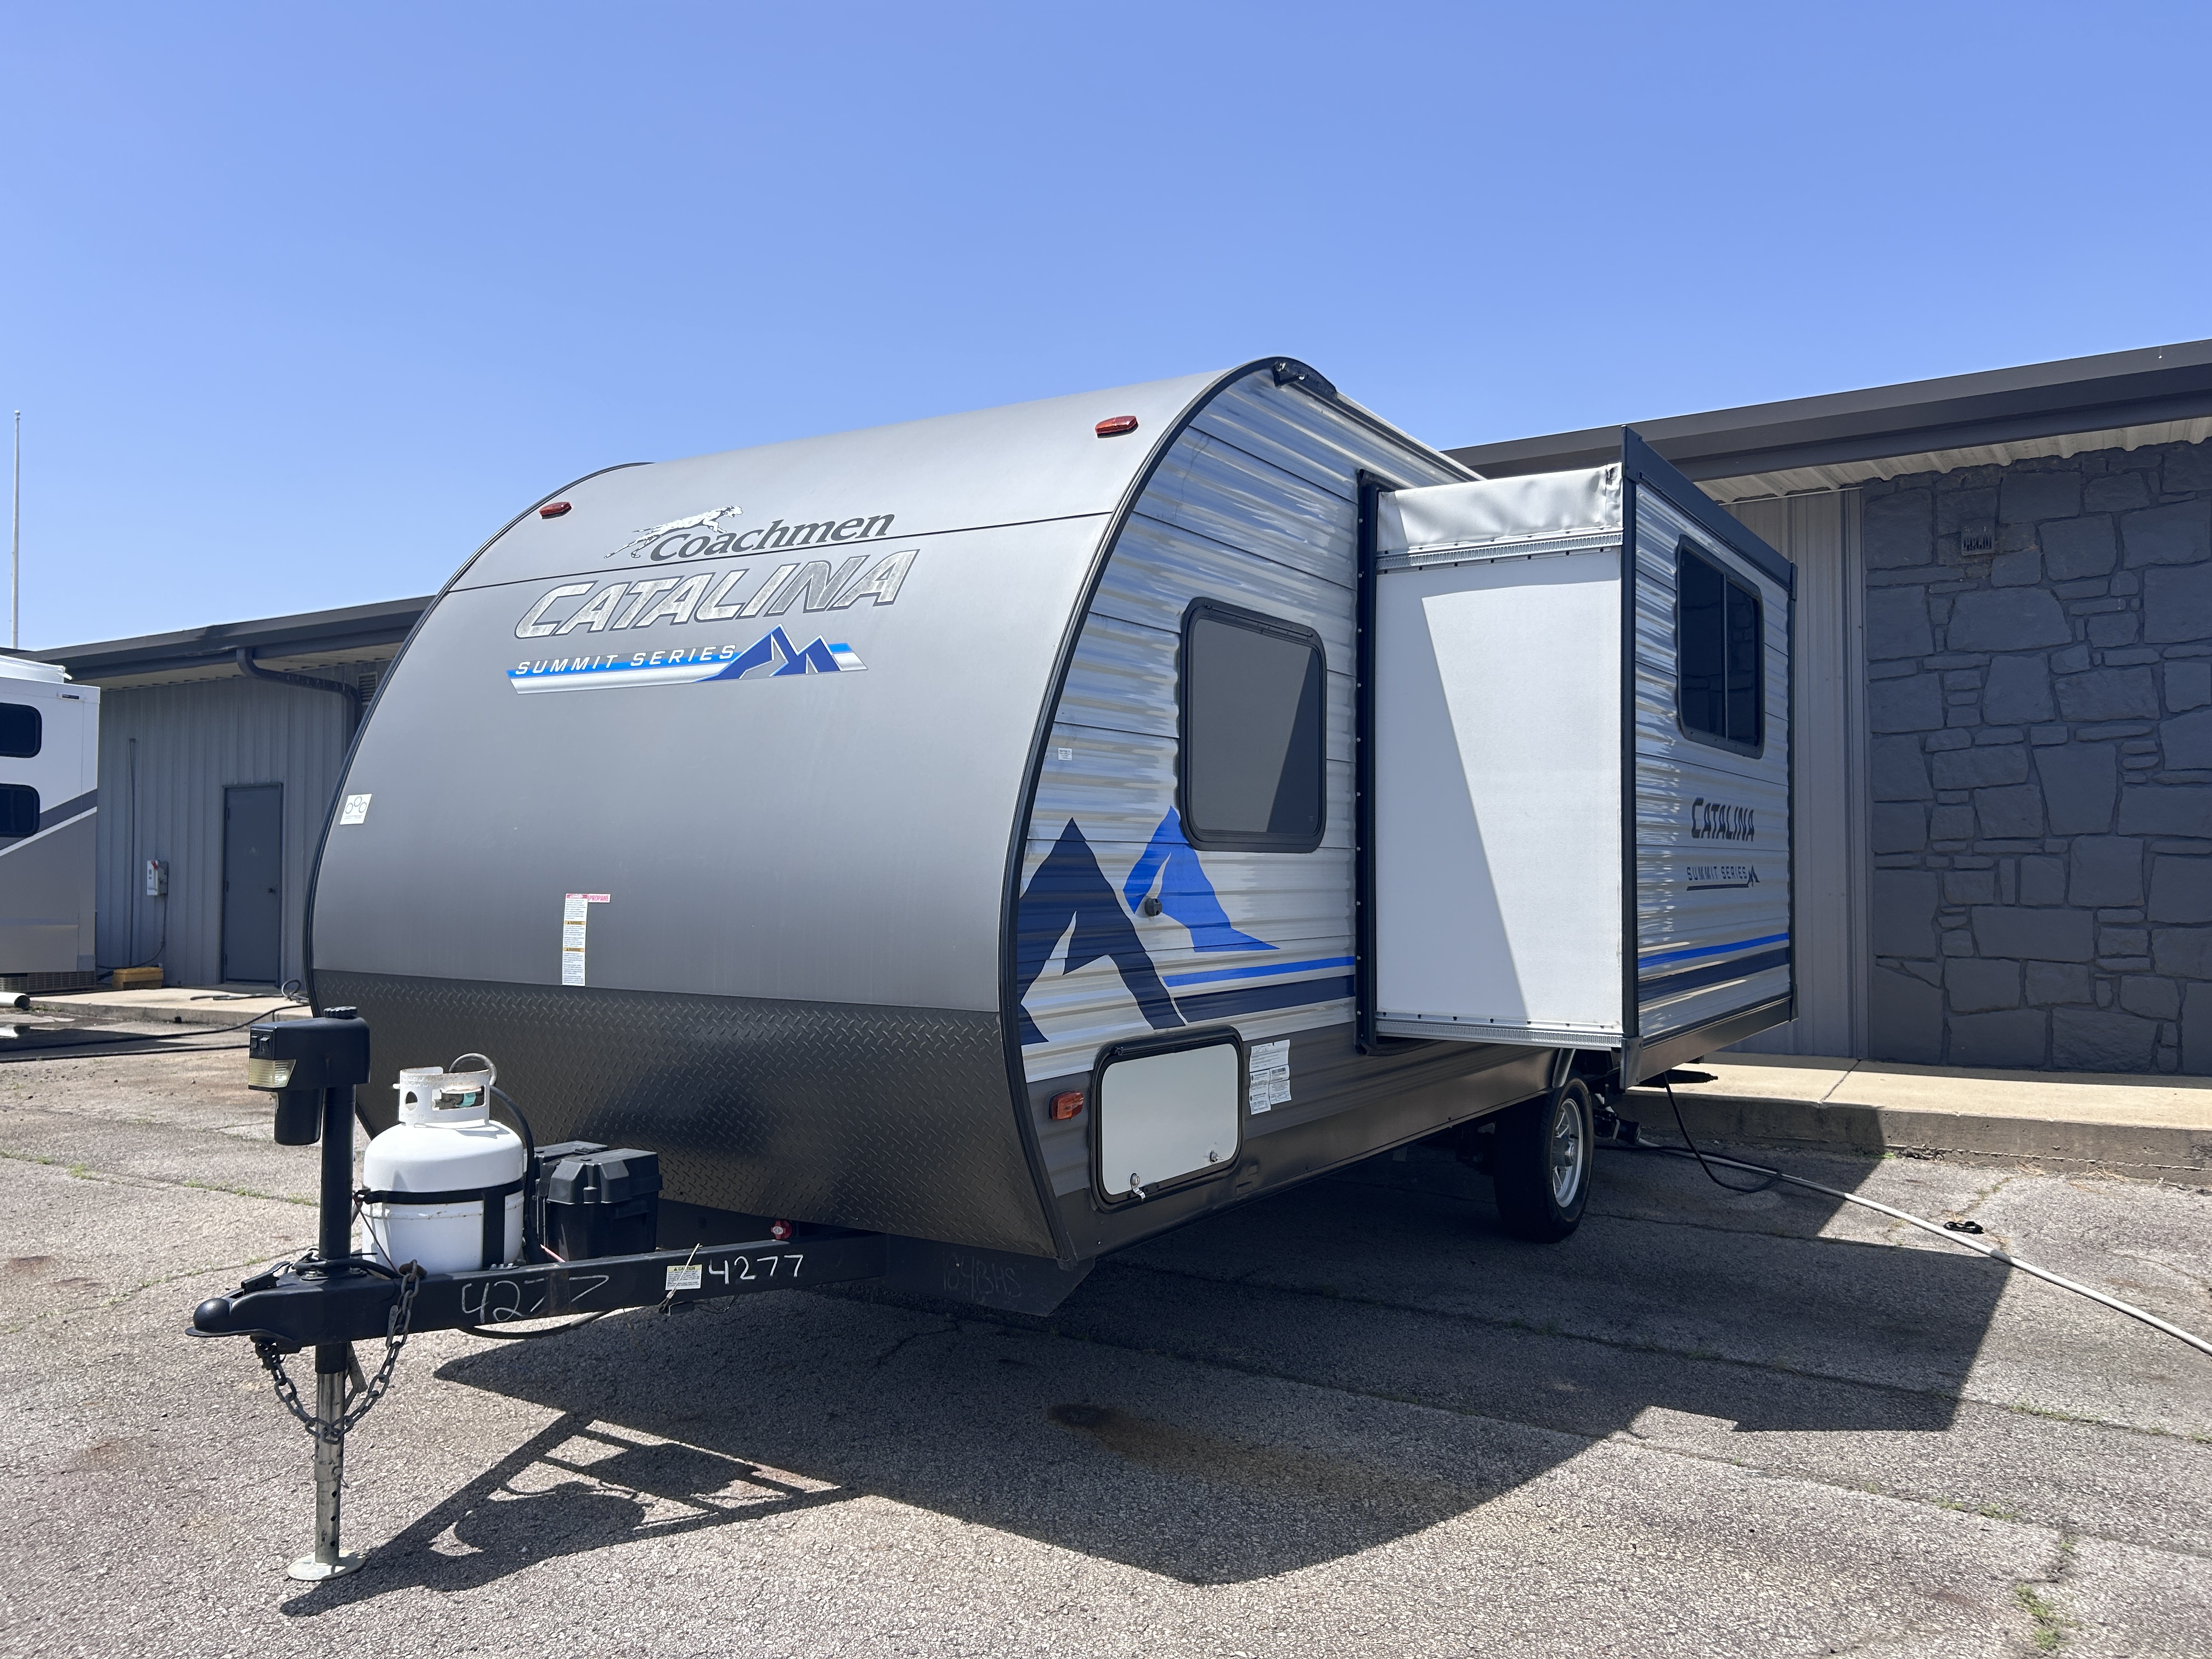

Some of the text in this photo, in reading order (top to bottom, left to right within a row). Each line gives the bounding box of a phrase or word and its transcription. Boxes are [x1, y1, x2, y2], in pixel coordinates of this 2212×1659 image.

[650, 514, 895, 561] Coachmen
[514, 549, 920, 639] CATALINA
[515, 645, 736, 675] SUMMIT SERIES
[1691, 797, 1754, 842] CATALINA
[1686, 866, 1747, 881] SUMMIT SERIES
[708, 1254, 804, 1285] 4277
[461, 1274, 610, 1324] 4277
